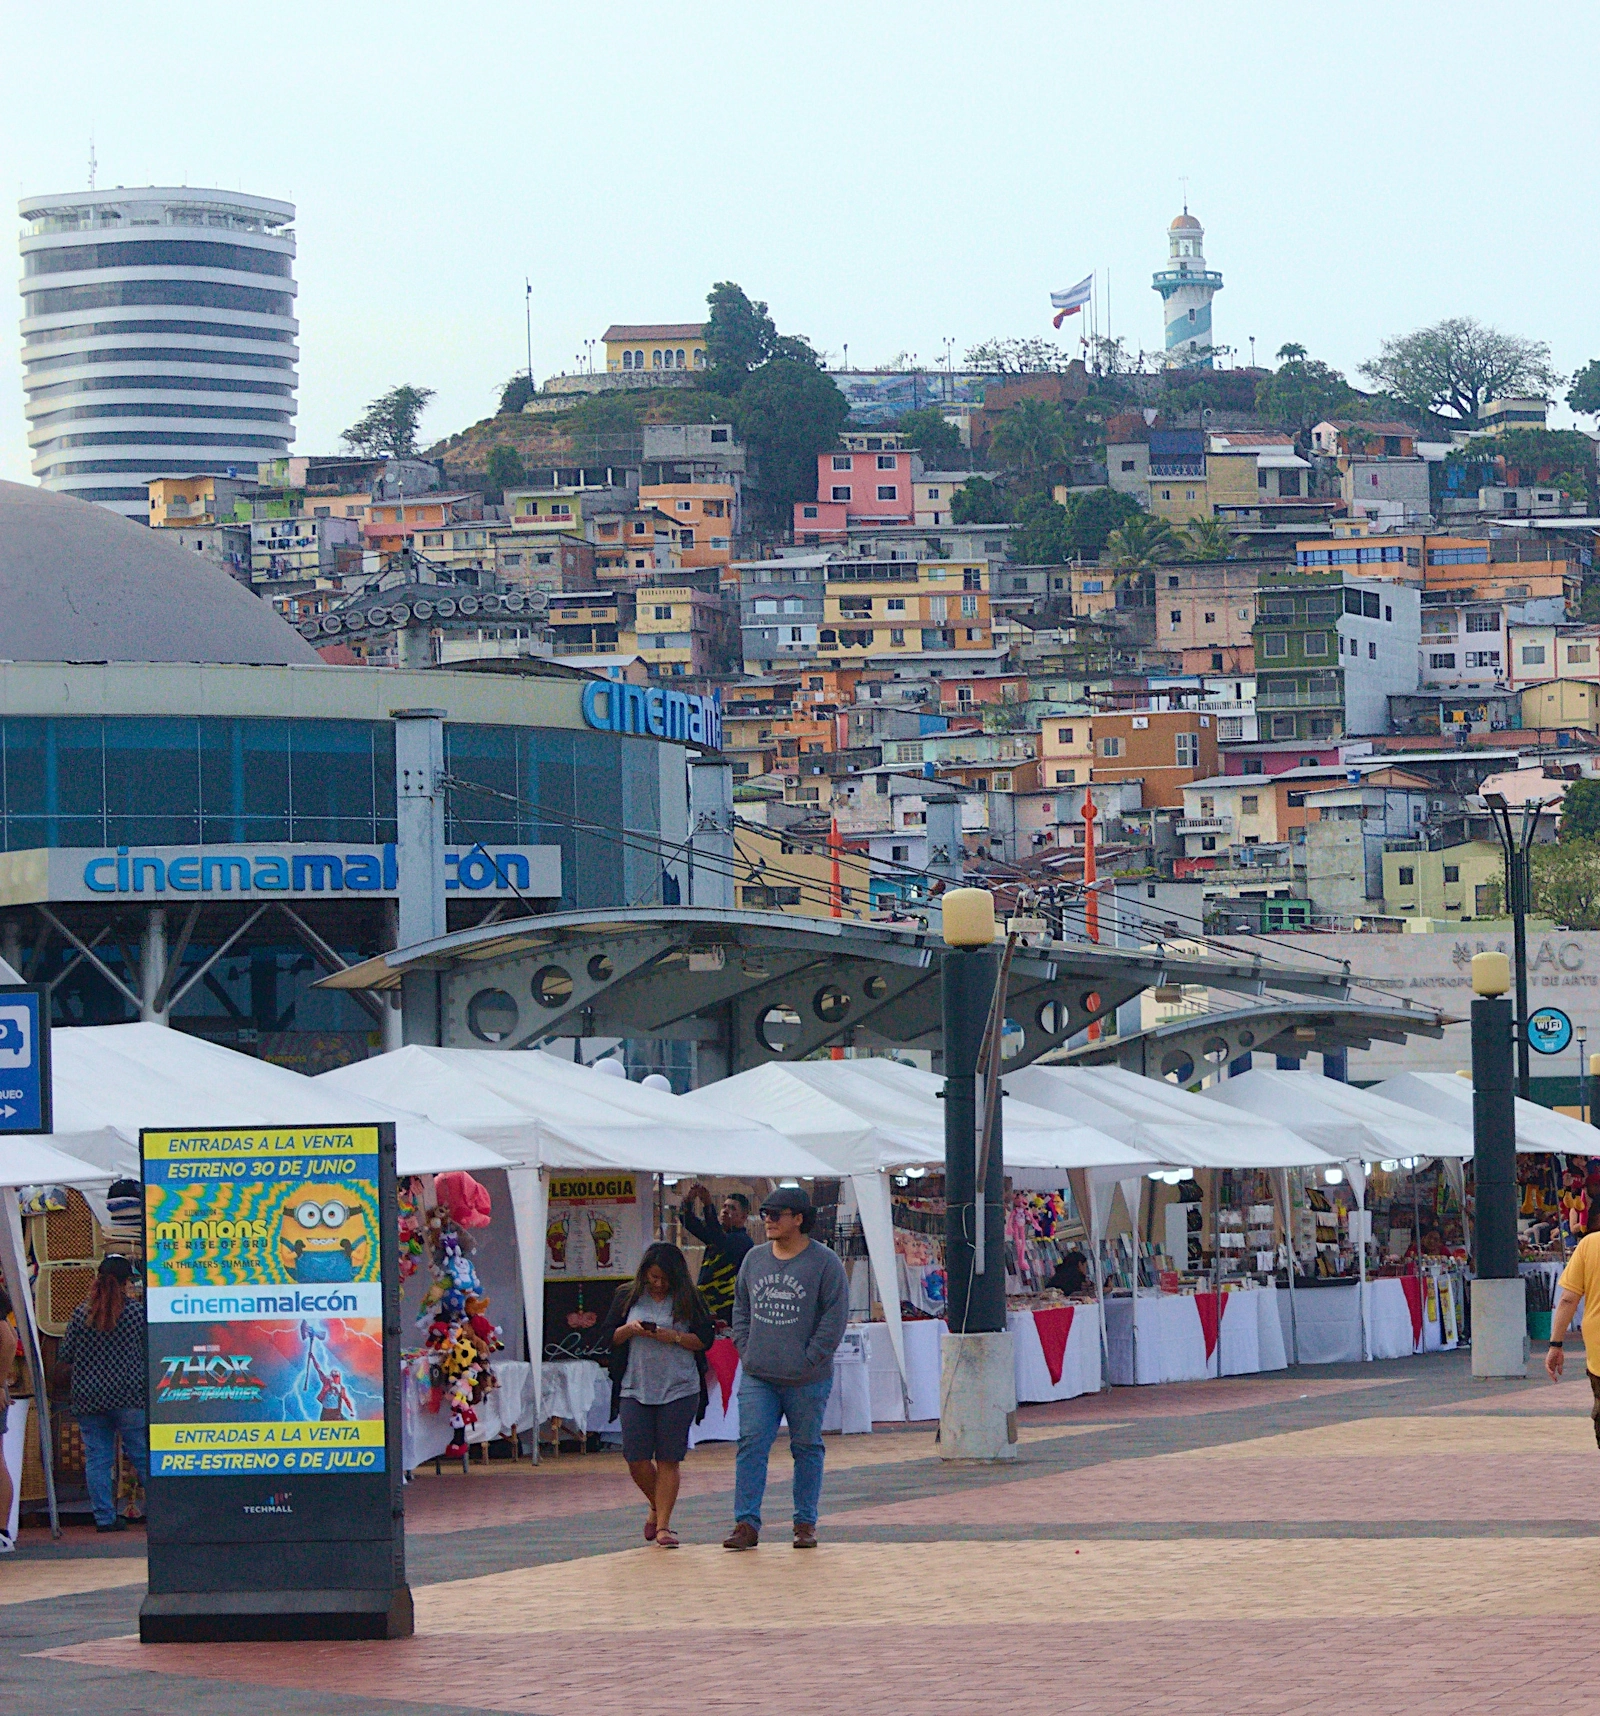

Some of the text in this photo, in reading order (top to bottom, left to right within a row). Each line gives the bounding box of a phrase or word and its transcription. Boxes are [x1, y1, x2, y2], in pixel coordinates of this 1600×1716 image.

[84, 841, 530, 893] cinemamalcón
[1542, 975, 1558, 987] DE
[1562, 975, 1598, 987] ARTE
[168, 1134, 354, 1153] ENTRADAS A LA VENTA
[168, 1159, 357, 1179] ESTRENO 30 DE JUNIO
[549, 1180, 634, 1197] LEXOLOGIA
[154, 1239, 268, 1250] THE RISE OF GRU
[163, 1260, 261, 1269] IN THEATERS SUMMER
[753, 1273, 781, 1297] ALPINE
[782, 1274, 807, 1300] PEAKS
[170, 1290, 358, 1315] cinemamalecón
[754, 1302, 800, 1313] EXPLORERS
[156, 1355, 267, 1389] THOR
[174, 1427, 360, 1444] ENTRADAS A LA VENTA
[161, 1451, 375, 1470] PRE-ESTRENO 6 DE JULIO
[243, 1505, 293, 1514] TECHMALL
